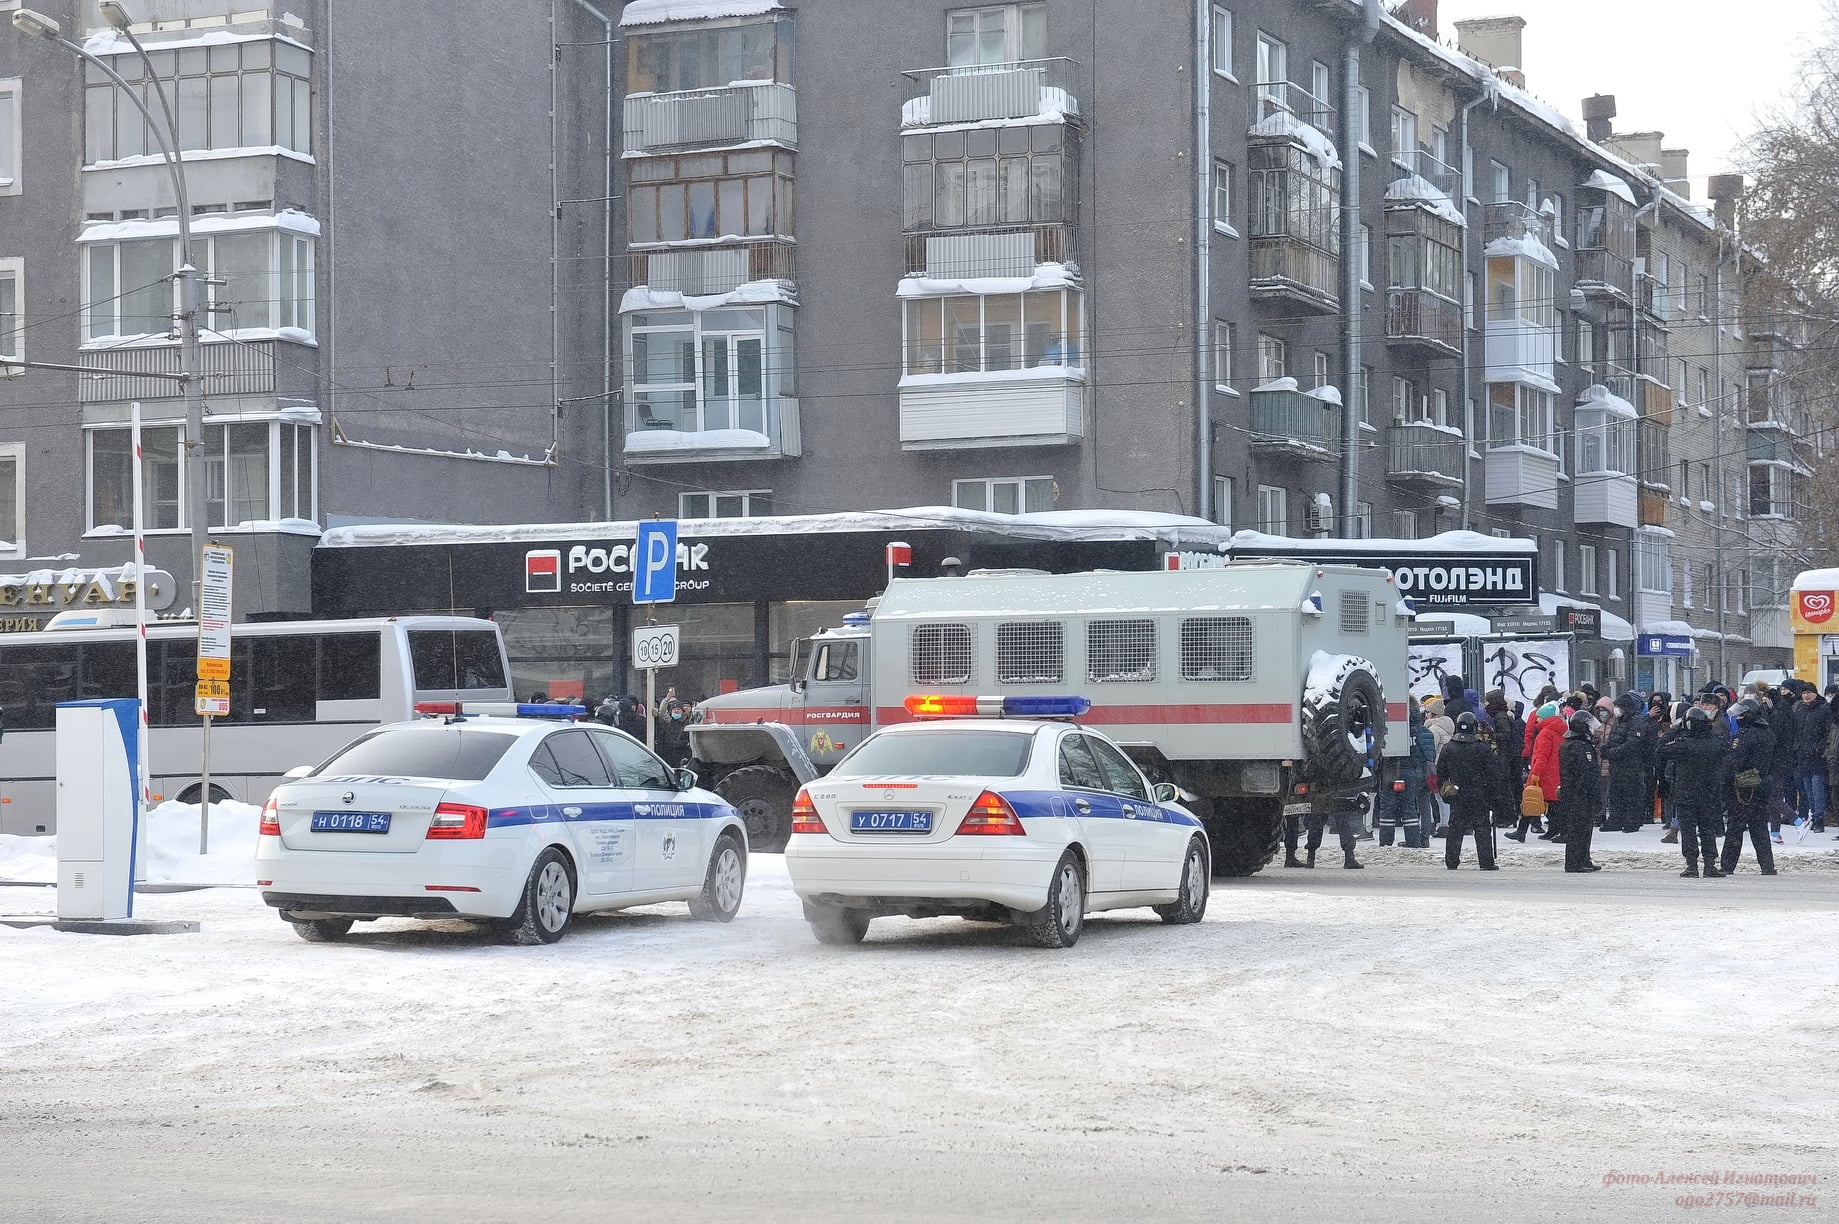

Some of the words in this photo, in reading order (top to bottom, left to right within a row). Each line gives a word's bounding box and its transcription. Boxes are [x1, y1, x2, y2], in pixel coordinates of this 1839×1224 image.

[568, 543, 709, 573] РОСНК
[645, 531, 669, 595] P
[1395, 567, 1523, 590] ОТОЛЭНД
[1429, 594, 1467, 603] FUJIFILM
[640, 645, 648, 656] 10
[651, 644, 659, 656] 15
[662, 641, 673, 656] 20
[650, 804, 685, 818] ПОЛИЦИЯ
[331, 814, 363, 828] 0118
[370, 814, 384, 825] 54
[870, 813, 905, 828] 0717
[912, 813, 927, 824] 54
